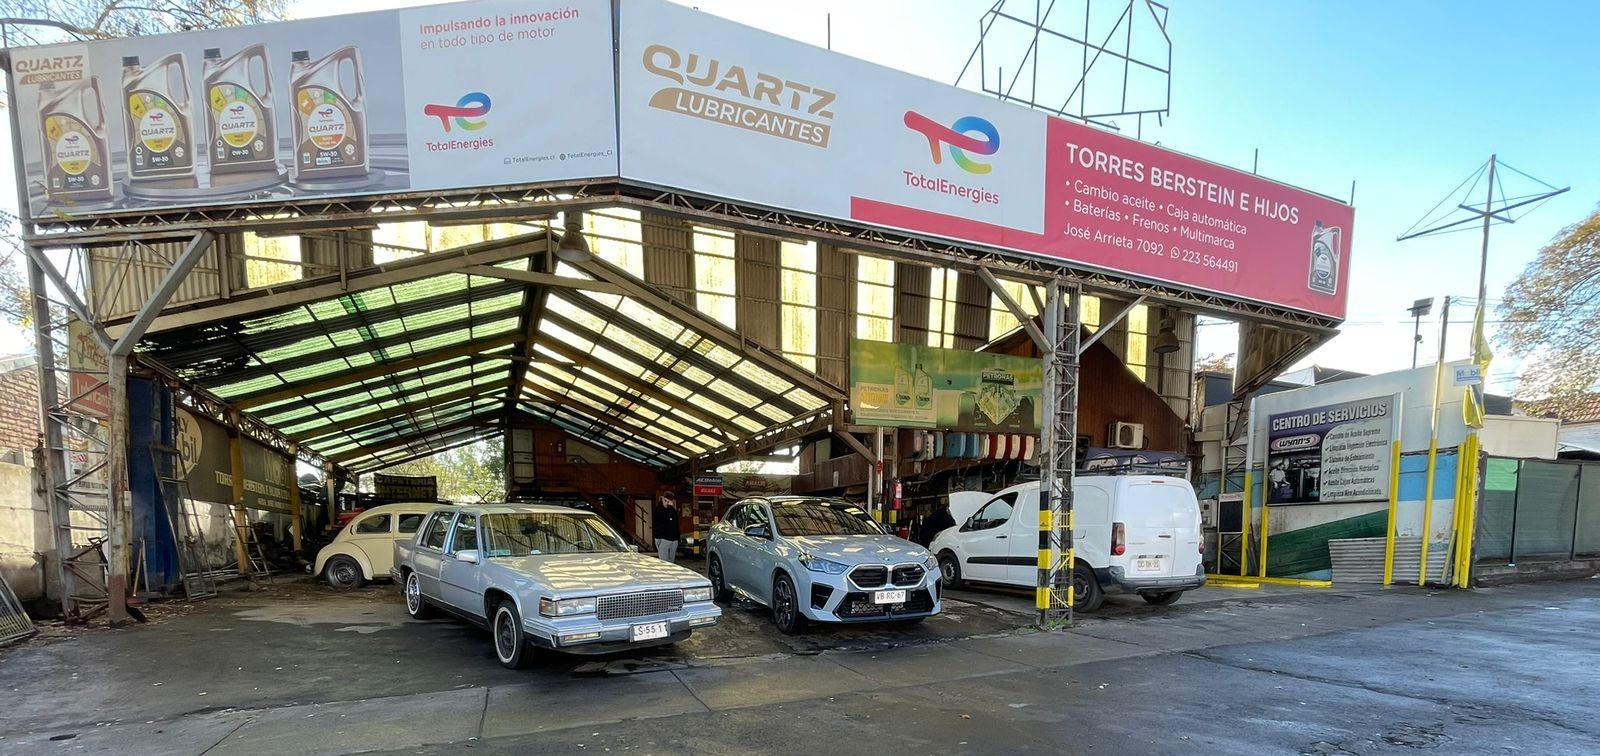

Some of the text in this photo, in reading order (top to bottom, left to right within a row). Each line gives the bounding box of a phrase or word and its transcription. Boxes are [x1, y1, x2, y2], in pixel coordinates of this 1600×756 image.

[420, 7, 579, 35] Impulsando la innovación
[420, 27, 555, 50] en todo tipo de motor
[16, 56, 83, 73] QUARTZ
[27, 70, 80, 84] LUBRICANTES
[643, 44, 836, 119] QUARTZ
[222, 122, 255, 130] QUARTZ
[309, 124, 344, 133] QUARTZ
[676, 92, 824, 144] LUBRICANTES
[142, 127, 174, 136] QUARTZ
[57, 150, 90, 159] QUARTZ
[426, 137, 494, 152] TotalEnergies
[903, 170, 1000, 204] TotalEnergies
[1066, 142, 1299, 224] TORRES BERSTEIN E HIJOS
[1074, 180, 1247, 235] Cambio aceite Caja automática
[1074, 199, 1235, 249] Baterías Frenos Multimarca
[1064, 222, 1238, 272] José Arrieta 7092 223 564491
[982, 372, 1013, 380] PETRONAS
[1272, 403, 1388, 431] CENTRO DE SERVICIOS
